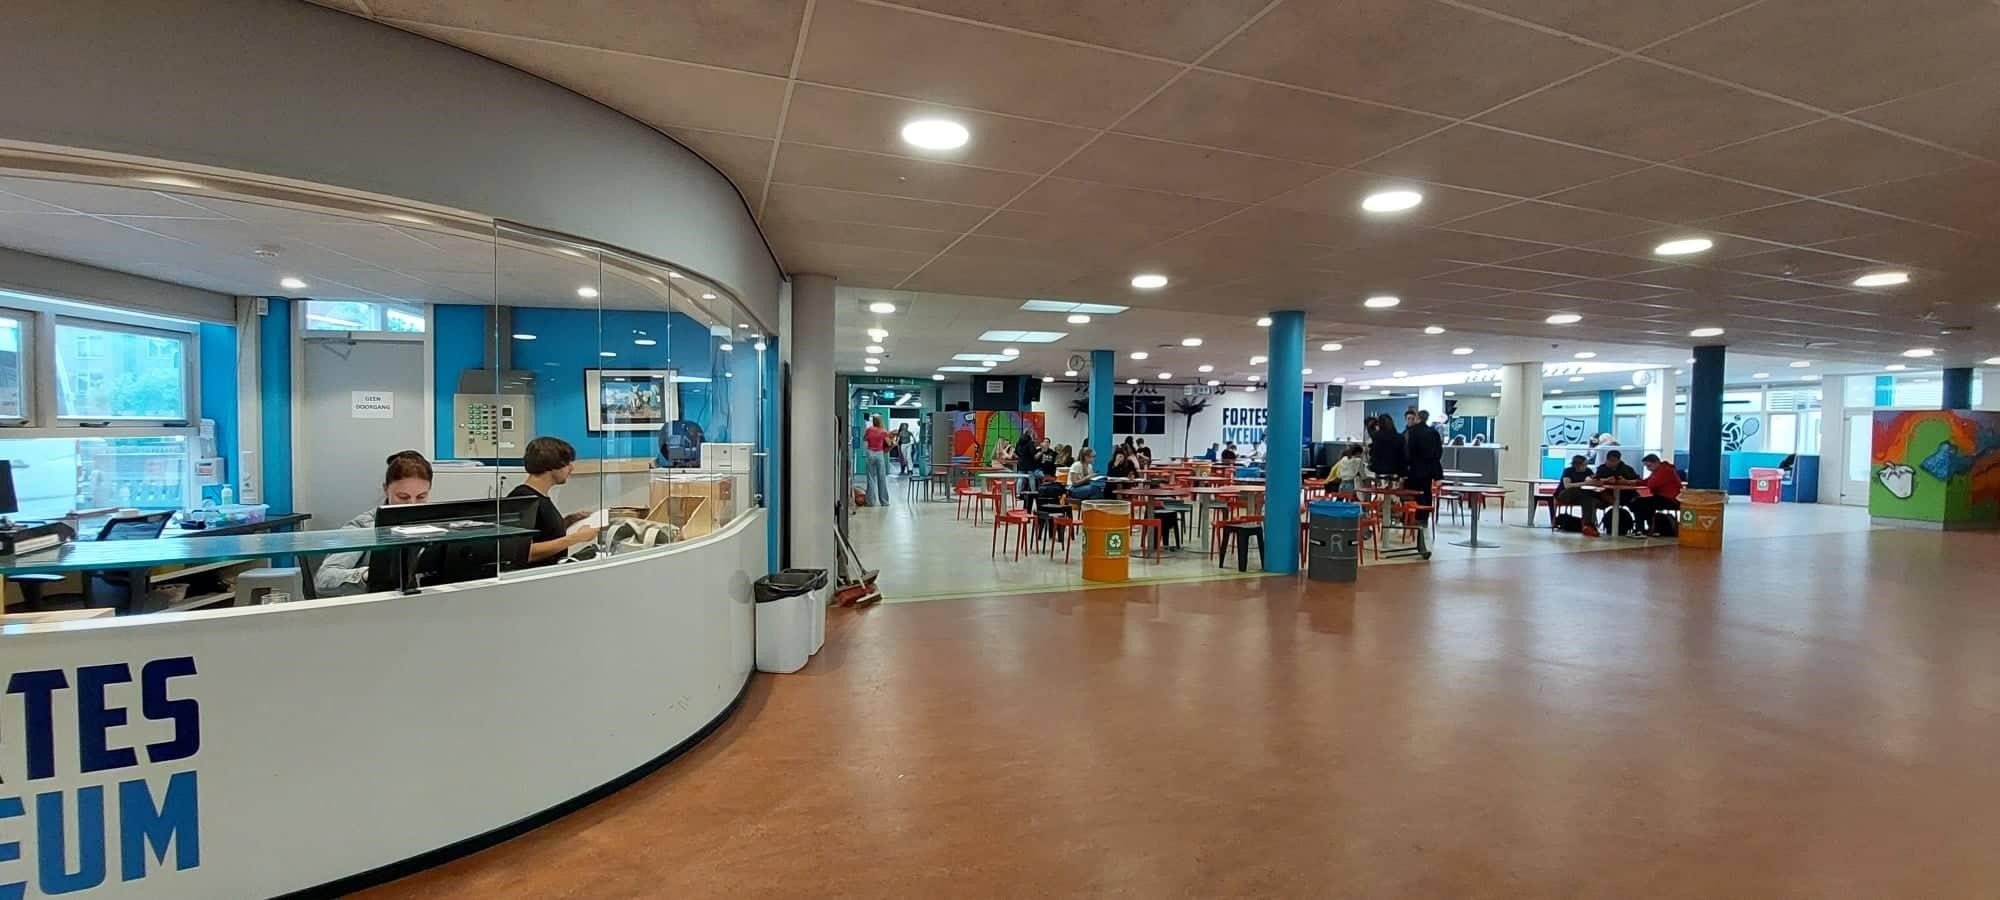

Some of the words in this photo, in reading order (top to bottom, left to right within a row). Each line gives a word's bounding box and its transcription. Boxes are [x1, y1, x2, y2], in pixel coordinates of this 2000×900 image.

[1222, 407, 1268, 426] FORTES
[1330, 534, 1343, 552] R
[0, 656, 200, 784] TES
